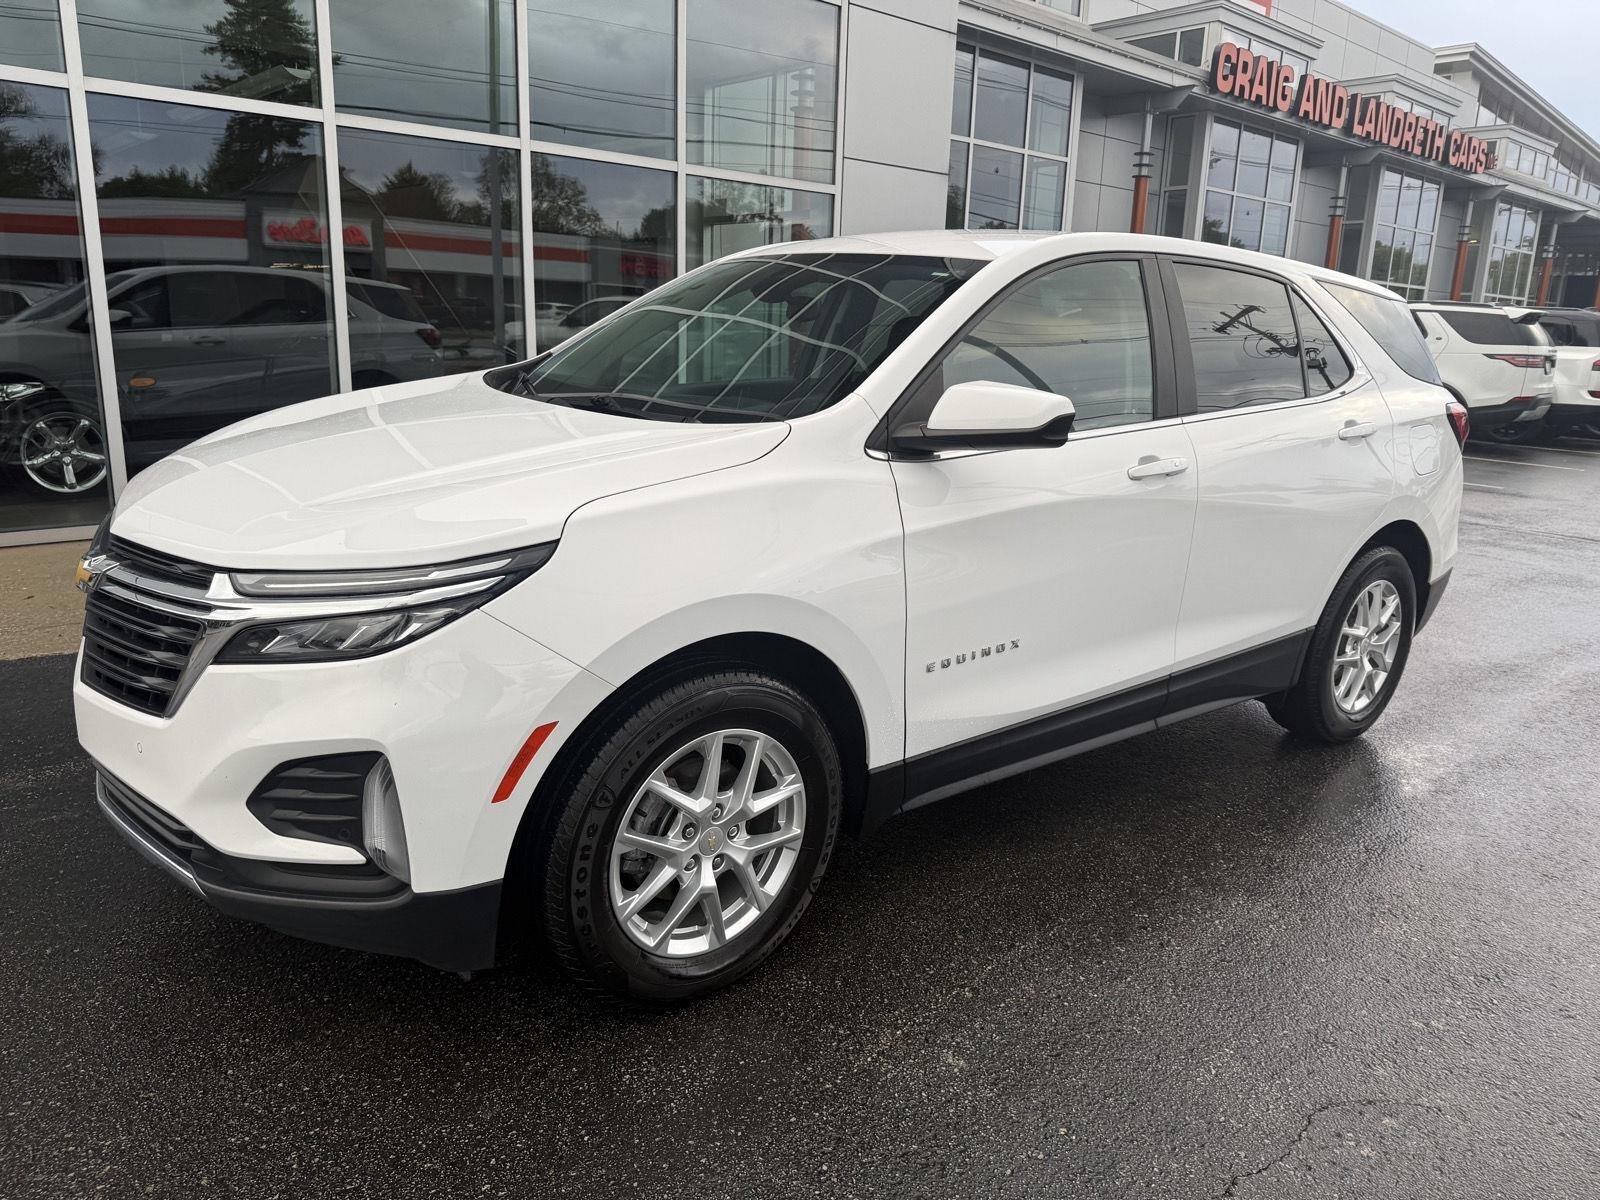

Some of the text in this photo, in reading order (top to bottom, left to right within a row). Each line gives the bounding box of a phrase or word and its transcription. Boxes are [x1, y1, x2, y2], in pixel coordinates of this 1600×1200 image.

[1217, 42, 1294, 112] CRAIG
[1299, 73, 1349, 129] AND
[1353, 92, 1448, 162] LANDRETH
[1449, 129, 1487, 173] CARS
[926, 639, 1020, 673] EQUINOX
[574, 821, 605, 965] estone
